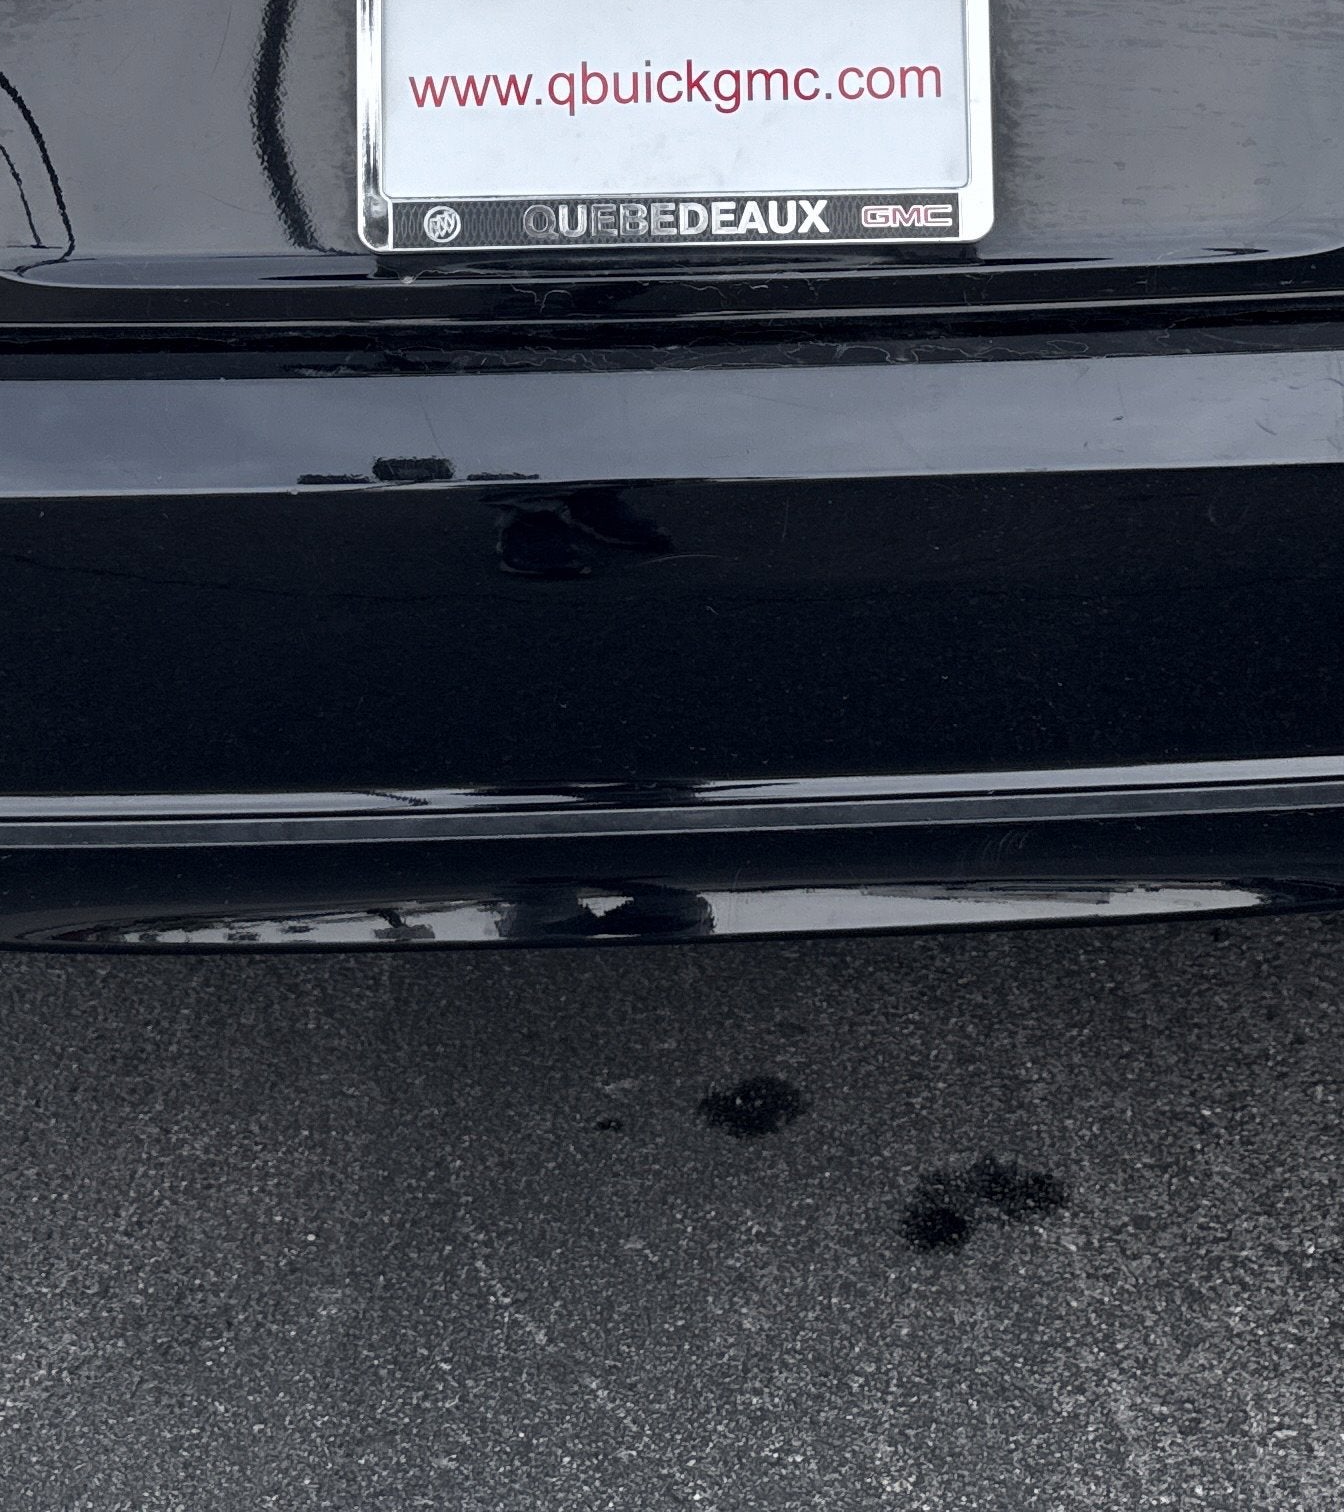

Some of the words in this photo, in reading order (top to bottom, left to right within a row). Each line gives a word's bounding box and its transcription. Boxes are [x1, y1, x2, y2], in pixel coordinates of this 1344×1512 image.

[409, 60, 943, 116] www.qbuickgmc.com
[523, 200, 830, 238] QUEBEDEAUX
[862, 204, 953, 229] GMC
